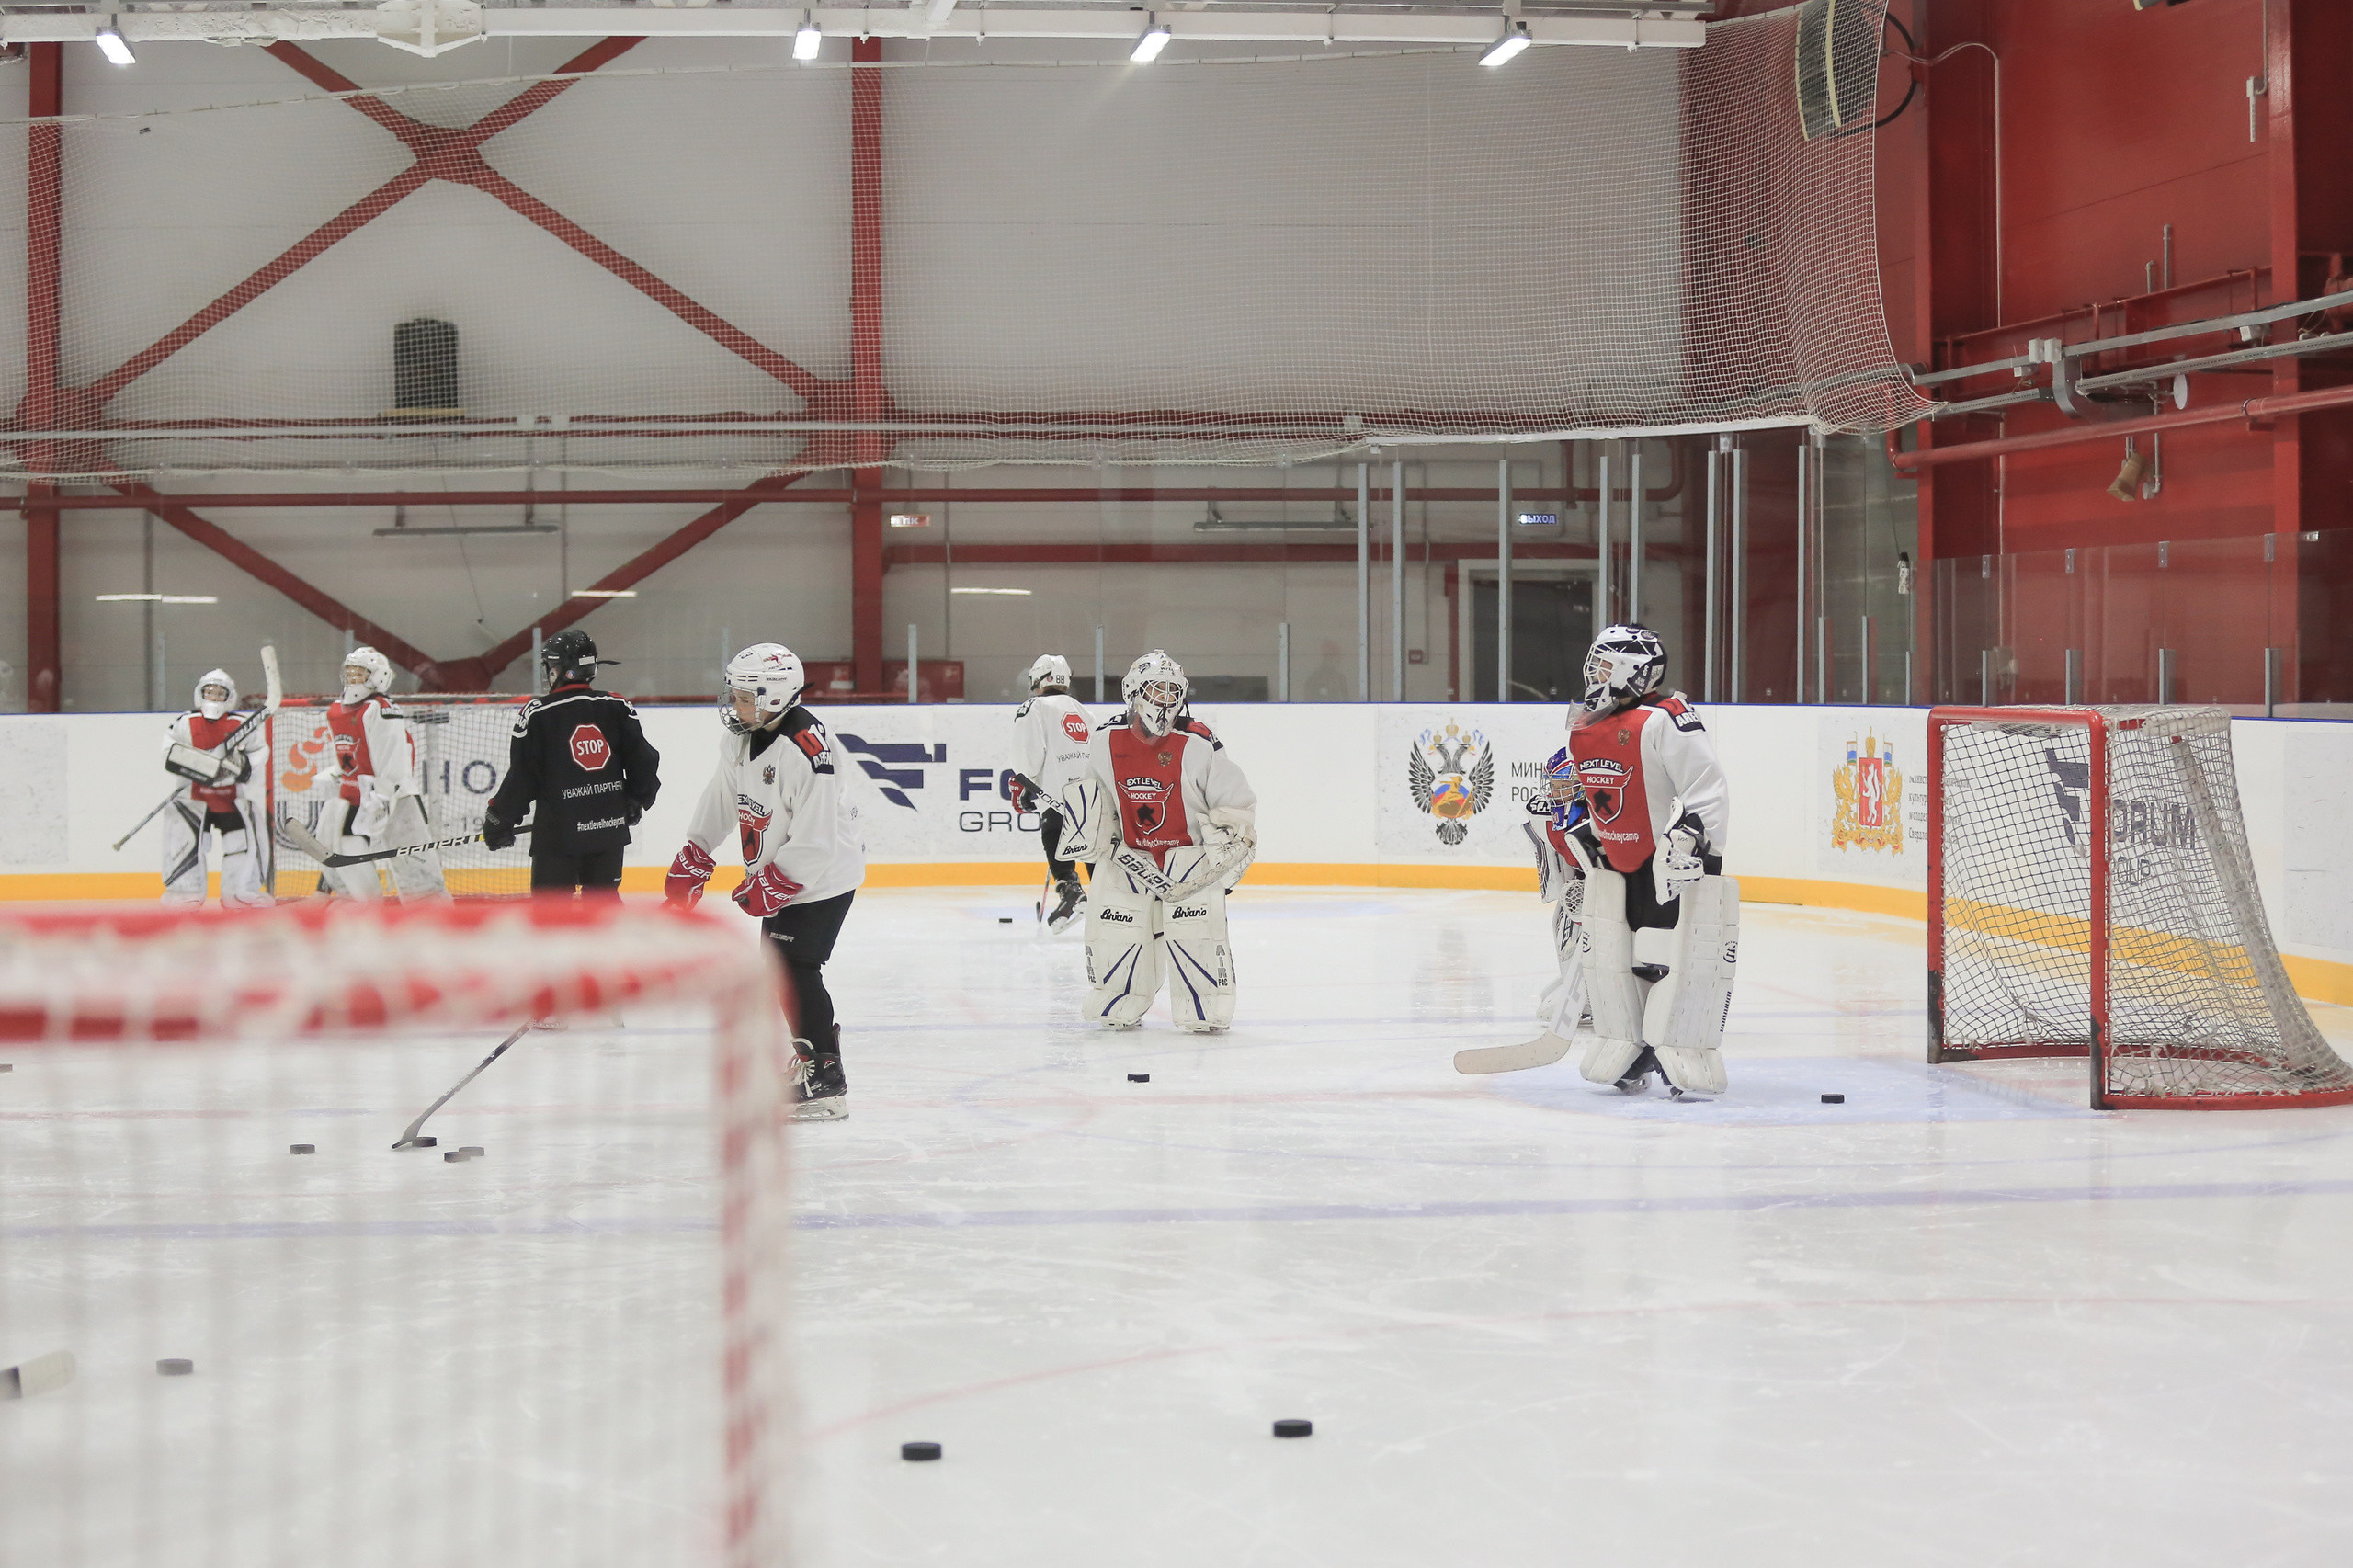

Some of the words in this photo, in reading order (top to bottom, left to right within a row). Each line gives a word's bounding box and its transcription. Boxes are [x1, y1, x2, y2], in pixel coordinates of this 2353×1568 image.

[1056, 675, 1064, 684] 88
[1065, 722, 1086, 733] STOP
[576, 739, 604, 756] STOP
[1057, 751, 1082, 763] УВАЖАЙ
[1579, 760, 1600, 770] NEXT
[1600, 759, 1623, 772] LEVEL
[1126, 778, 1141, 786] EXT
[1141, 778, 1162, 790] LEVEL
[1586, 776, 1615, 784] HOCKEY
[562, 783, 593, 799] УВАЖАЙ
[2112, 798, 2196, 849] ORUM
[1062, 843, 1089, 856] Brian's
[1100, 908, 1133, 923] Brian's
[1172, 906, 1207, 919] Brian's
